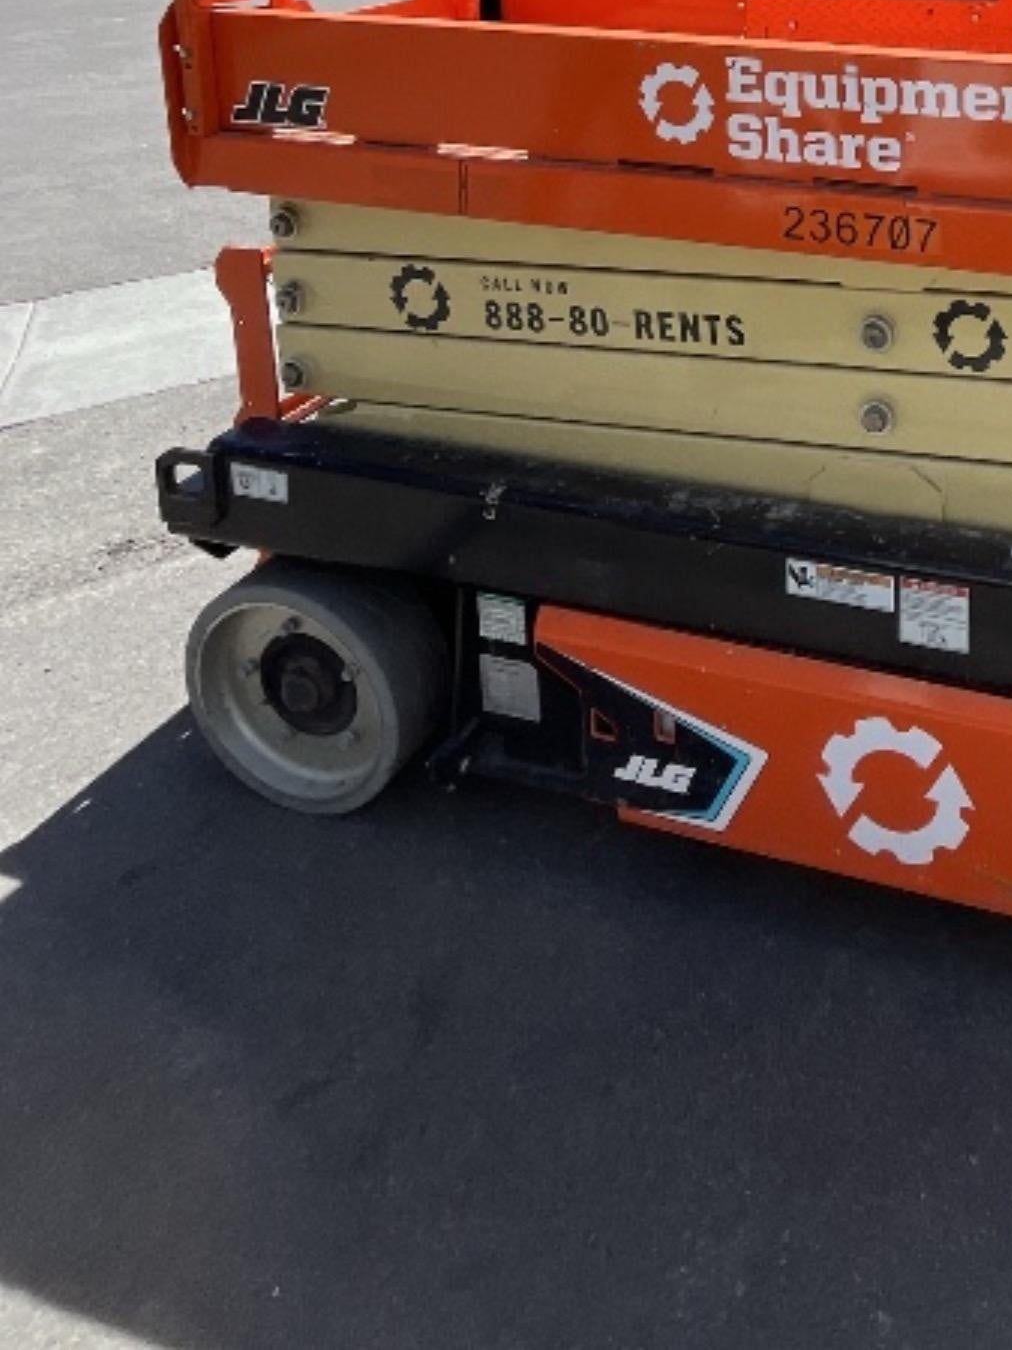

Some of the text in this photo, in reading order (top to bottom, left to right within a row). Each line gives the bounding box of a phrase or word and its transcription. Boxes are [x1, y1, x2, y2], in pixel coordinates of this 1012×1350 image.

[231, 80, 330, 129] JLG
[727, 113, 901, 172] Share
[783, 206, 938, 253] 236707
[480, 275, 523, 292] CALL
[614, 755, 697, 793] JLG
